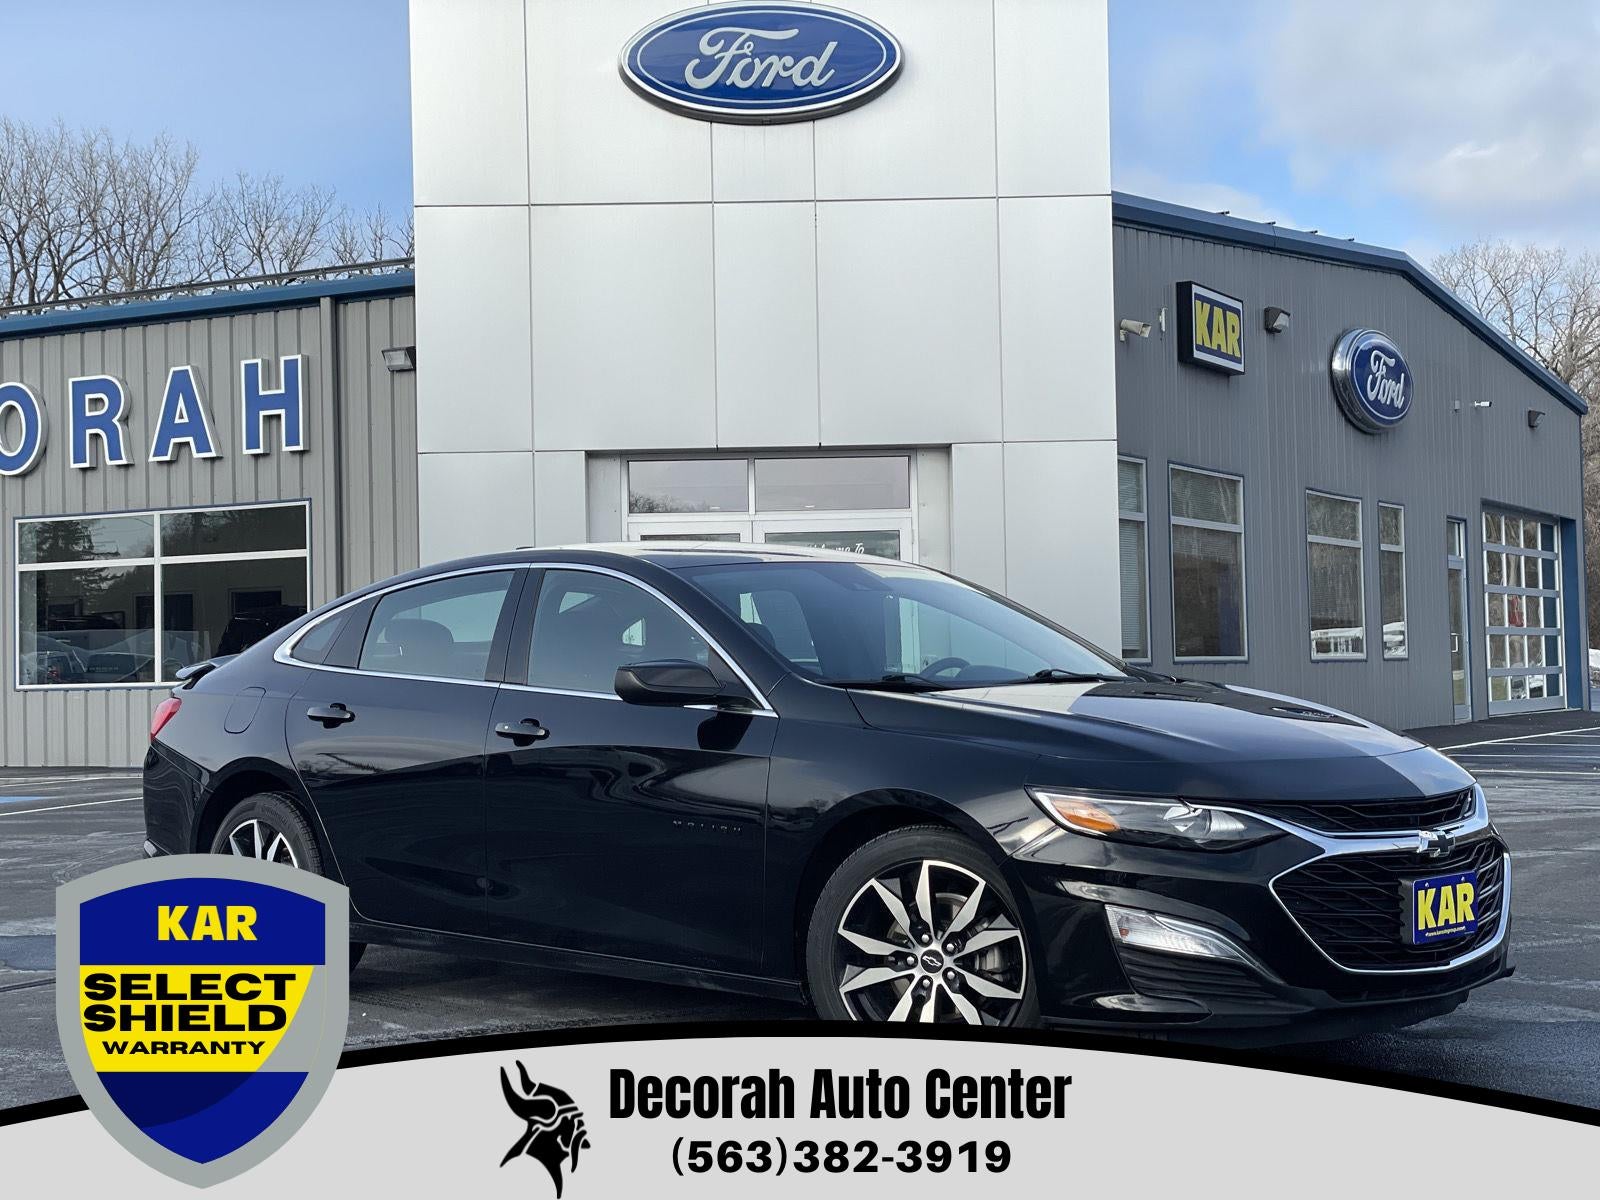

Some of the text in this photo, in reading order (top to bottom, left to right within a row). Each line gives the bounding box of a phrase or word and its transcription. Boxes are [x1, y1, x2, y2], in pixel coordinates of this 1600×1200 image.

[685, 27, 837, 89] Ford
[1195, 299, 1241, 358] KAR
[1367, 351, 1405, 409] Ford
[0, 354, 309, 476] ORAH
[1417, 882, 1475, 930] KAR
